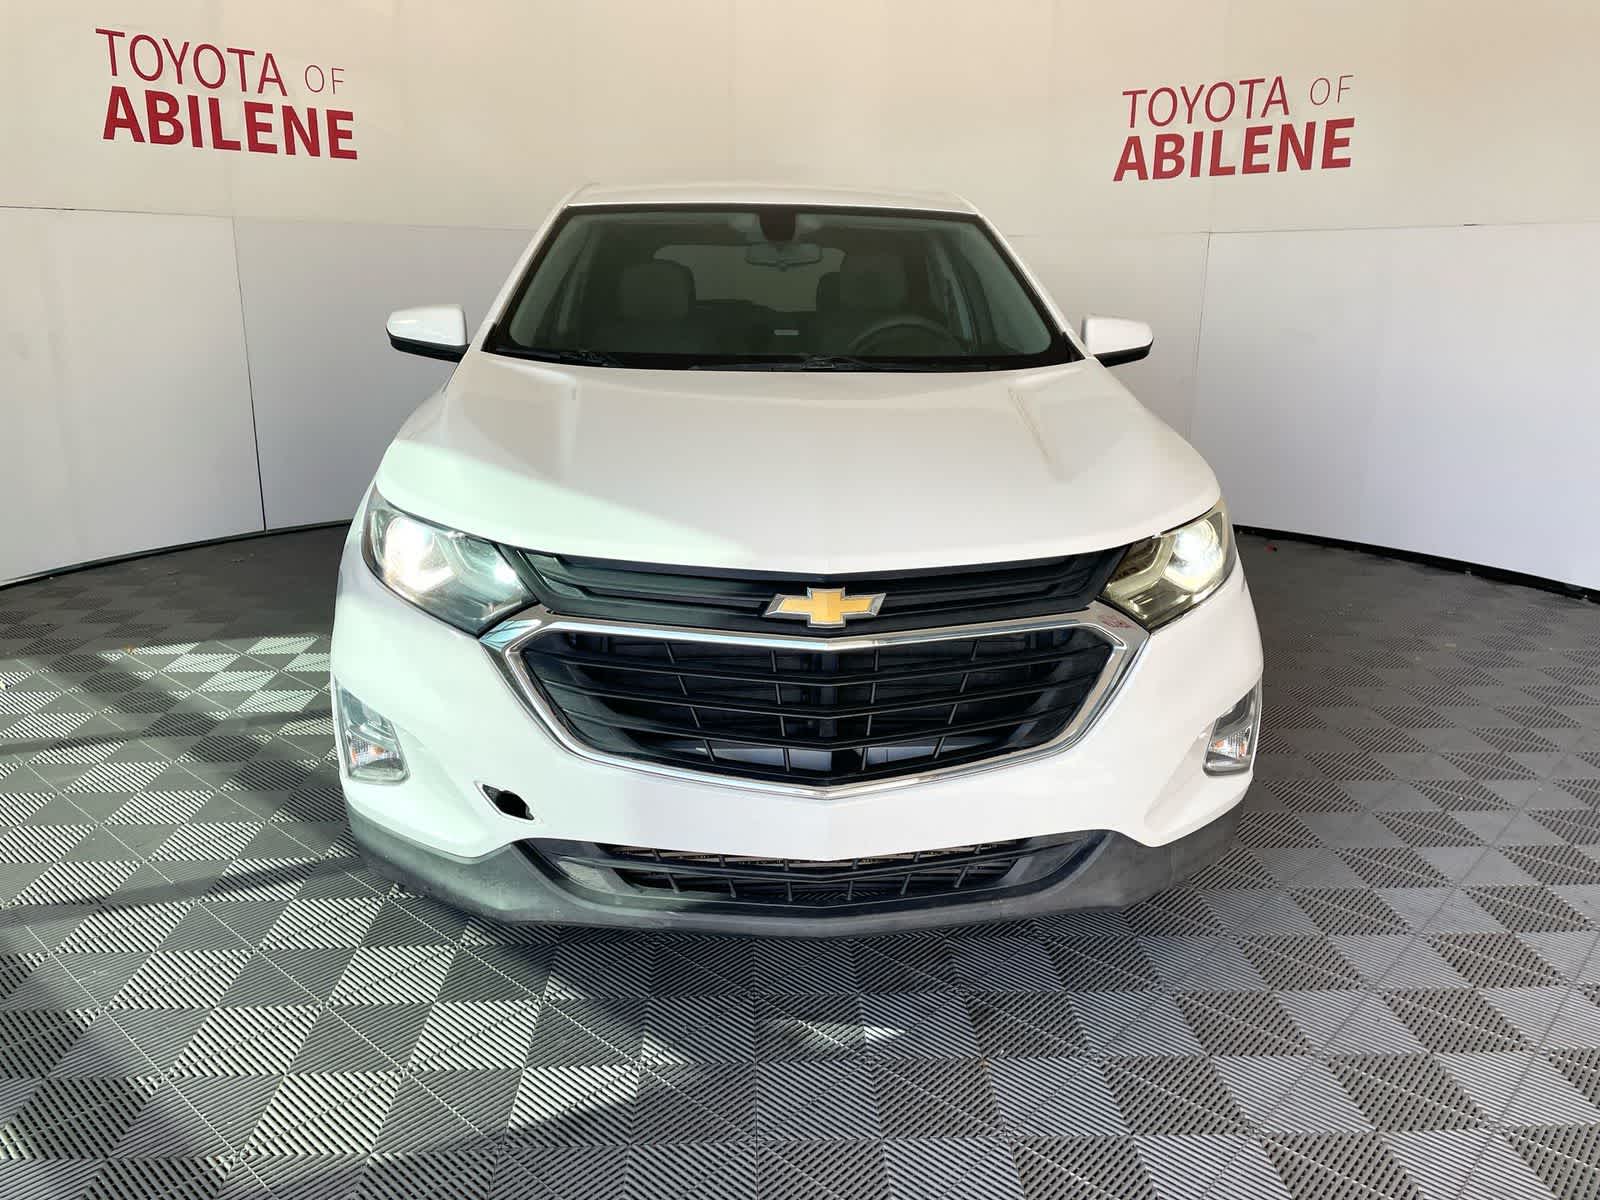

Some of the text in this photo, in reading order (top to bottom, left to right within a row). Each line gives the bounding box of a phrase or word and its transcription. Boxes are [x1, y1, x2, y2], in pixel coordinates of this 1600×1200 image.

[95, 27, 345, 96] TOYOTA OF
[103, 86, 358, 160] ABILENE
[1122, 75, 1354, 129] TOYOTA OF
[1113, 117, 1355, 182] ABILENE
